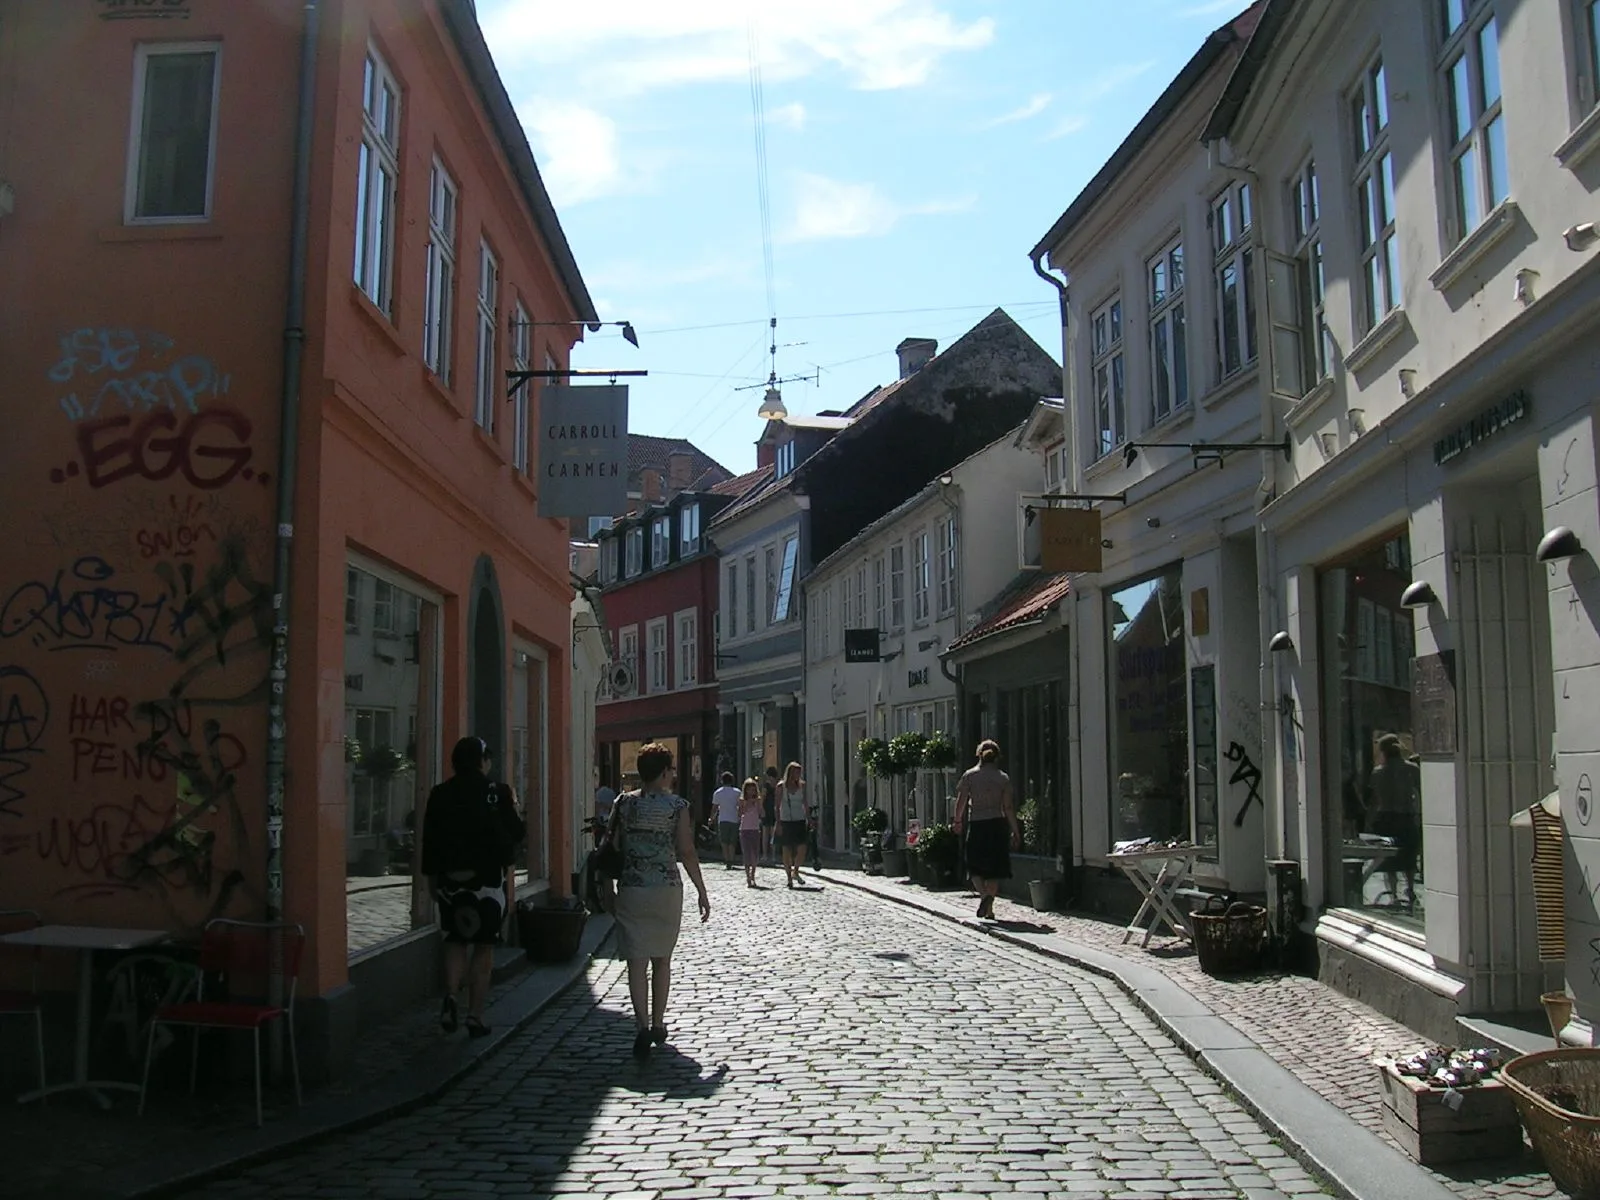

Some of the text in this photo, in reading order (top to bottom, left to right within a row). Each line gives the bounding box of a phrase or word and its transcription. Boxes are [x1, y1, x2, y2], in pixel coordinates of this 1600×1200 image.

[548, 425, 618, 440] CARROLL
[547, 462, 618, 477] CARMEN
[69, 693, 136, 735] HAR
